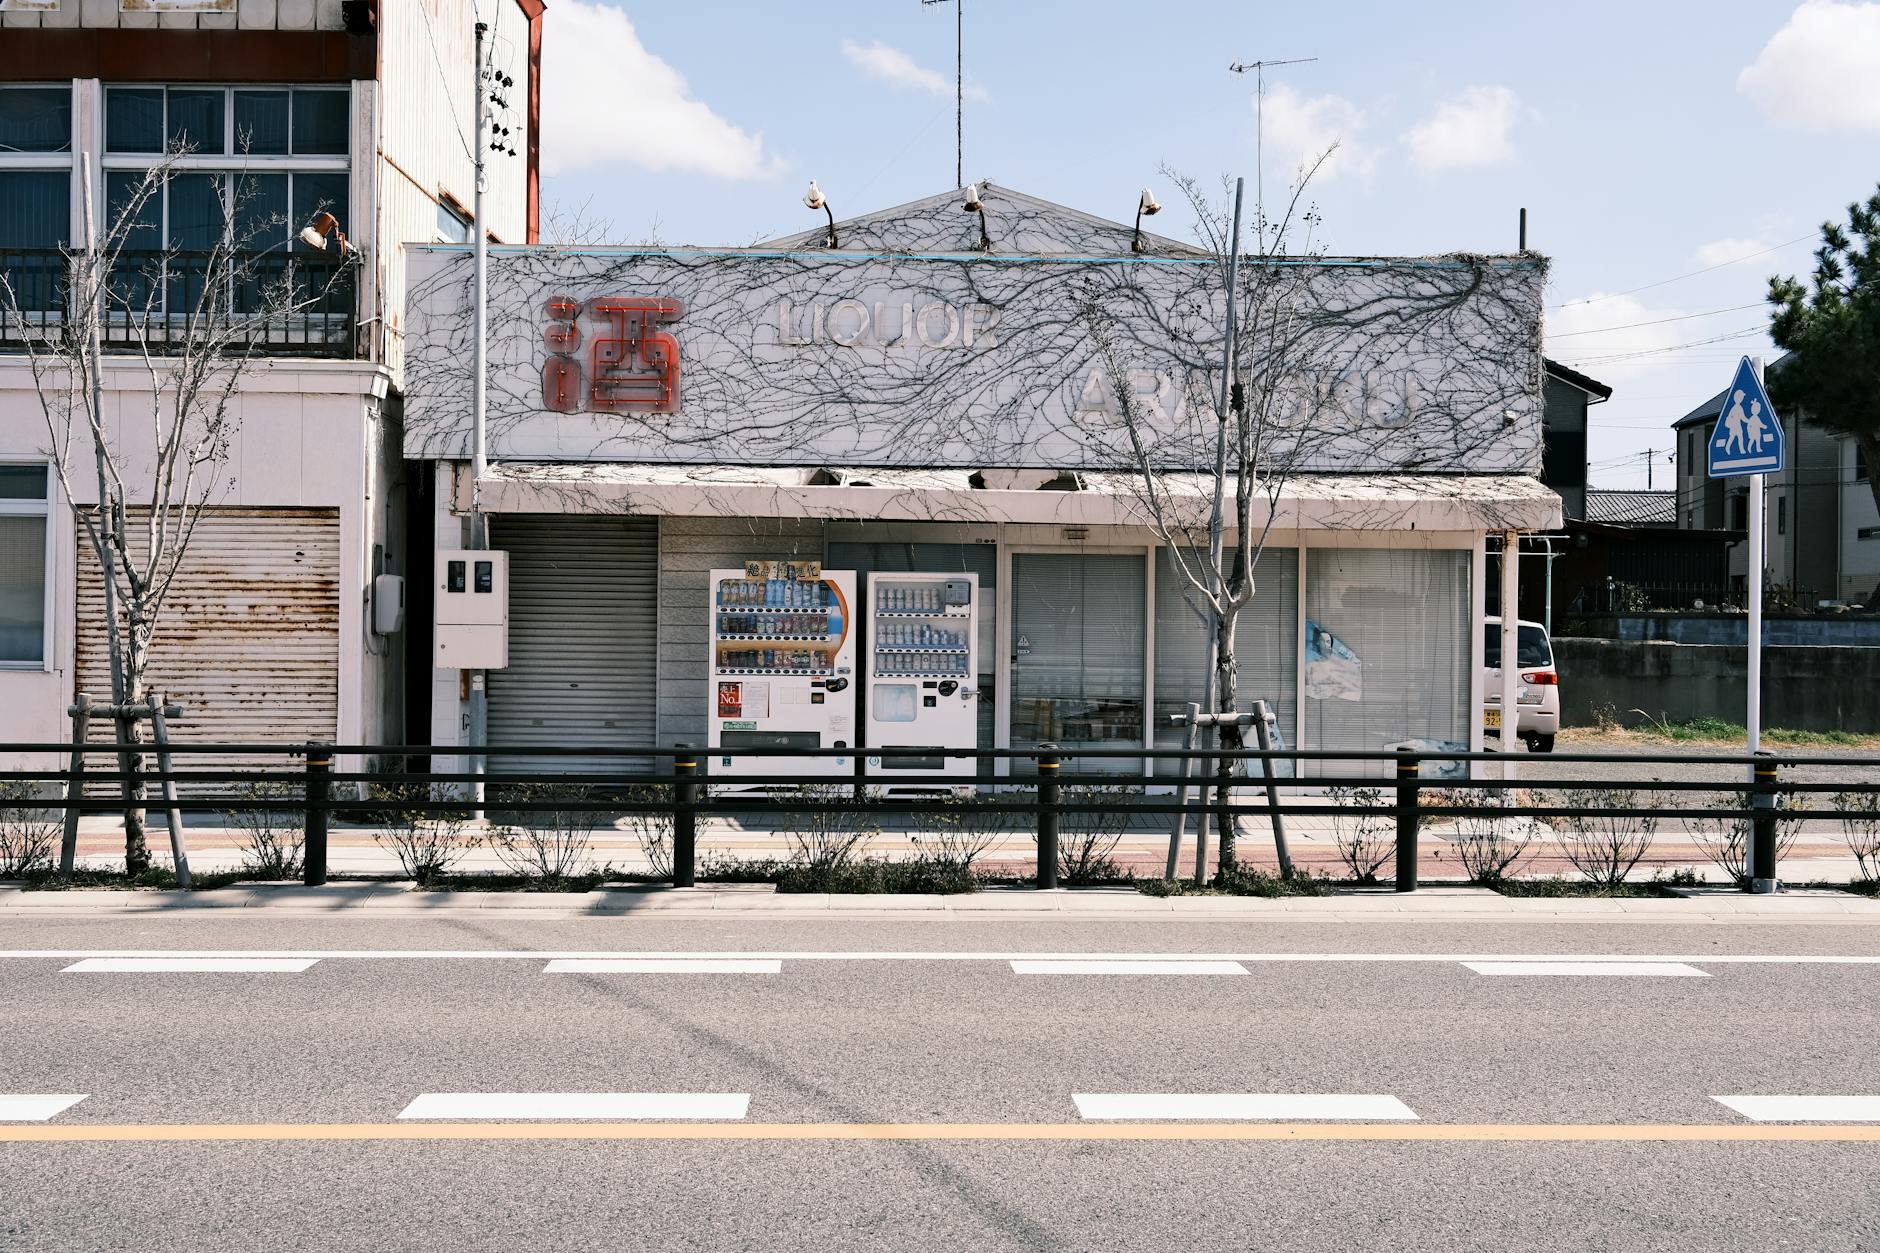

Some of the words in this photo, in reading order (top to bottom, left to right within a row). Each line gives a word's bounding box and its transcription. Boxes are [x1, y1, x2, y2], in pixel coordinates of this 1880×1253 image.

[778, 299, 1003, 349] LIQUOR
[542, 295, 684, 414] 酒
[719, 685, 736, 694] 売上
